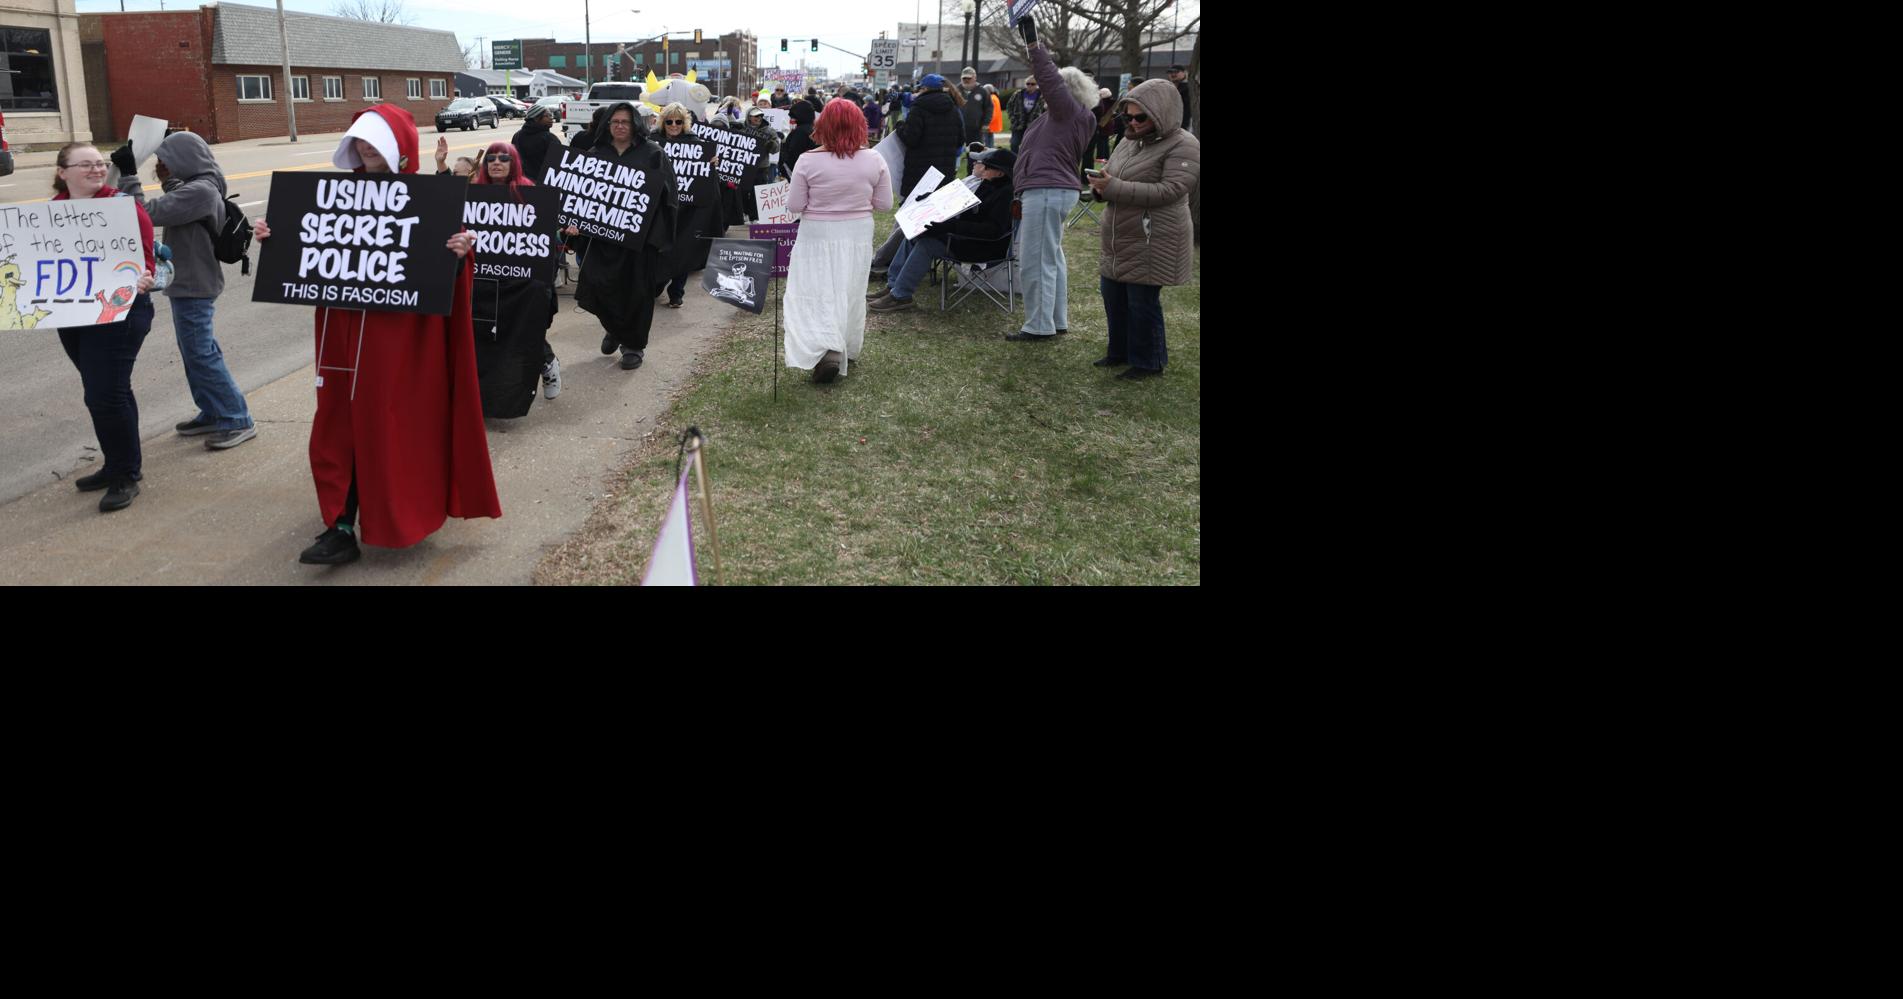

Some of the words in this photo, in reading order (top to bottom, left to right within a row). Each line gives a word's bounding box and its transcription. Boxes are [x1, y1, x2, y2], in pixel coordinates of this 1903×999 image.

[873, 55, 894, 67] 35
[691, 123, 757, 151] APPOINTING
[560, 150, 646, 189] LABELING
[673, 159, 710, 177] WITH
[316, 179, 411, 212] USING
[543, 167, 650, 213] MINORITIES
[760, 183, 790, 199] SAVE
[0, 207, 41, 229] The
[47, 205, 108, 228] letters
[462, 201, 537, 227] NORING
[562, 193, 643, 233] ENEMIES
[300, 212, 420, 248] SECRET
[579, 221, 625, 242] FASCISM
[30, 234, 64, 253] the
[74, 232, 106, 262] day
[110, 236, 138, 252] are
[36, 256, 100, 296] FDT
[298, 247, 408, 284] POLICE
[480, 263, 531, 278] FASCISM
[282, 283, 318, 299] THIS
[322, 285, 338, 301] IS
[342, 287, 419, 306] FASCISM
